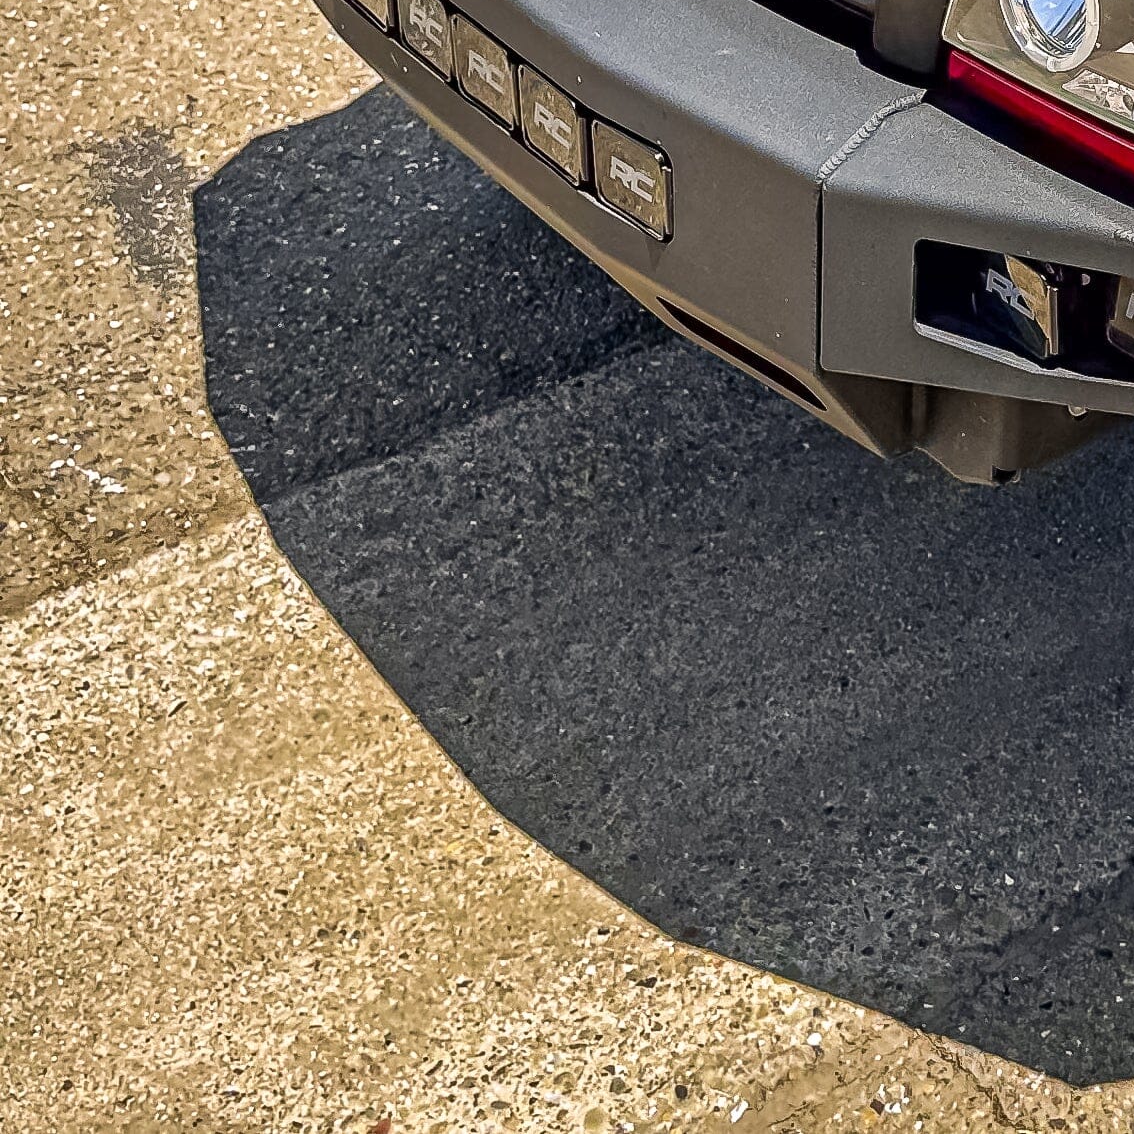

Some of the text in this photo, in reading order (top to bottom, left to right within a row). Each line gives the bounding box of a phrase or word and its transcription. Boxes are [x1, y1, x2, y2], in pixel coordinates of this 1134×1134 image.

[409, 0, 444, 48] RC
[467, 49, 506, 96] RC
[533, 101, 572, 150] RC
[609, 155, 656, 202] RC
[985, 268, 1037, 321] RC
